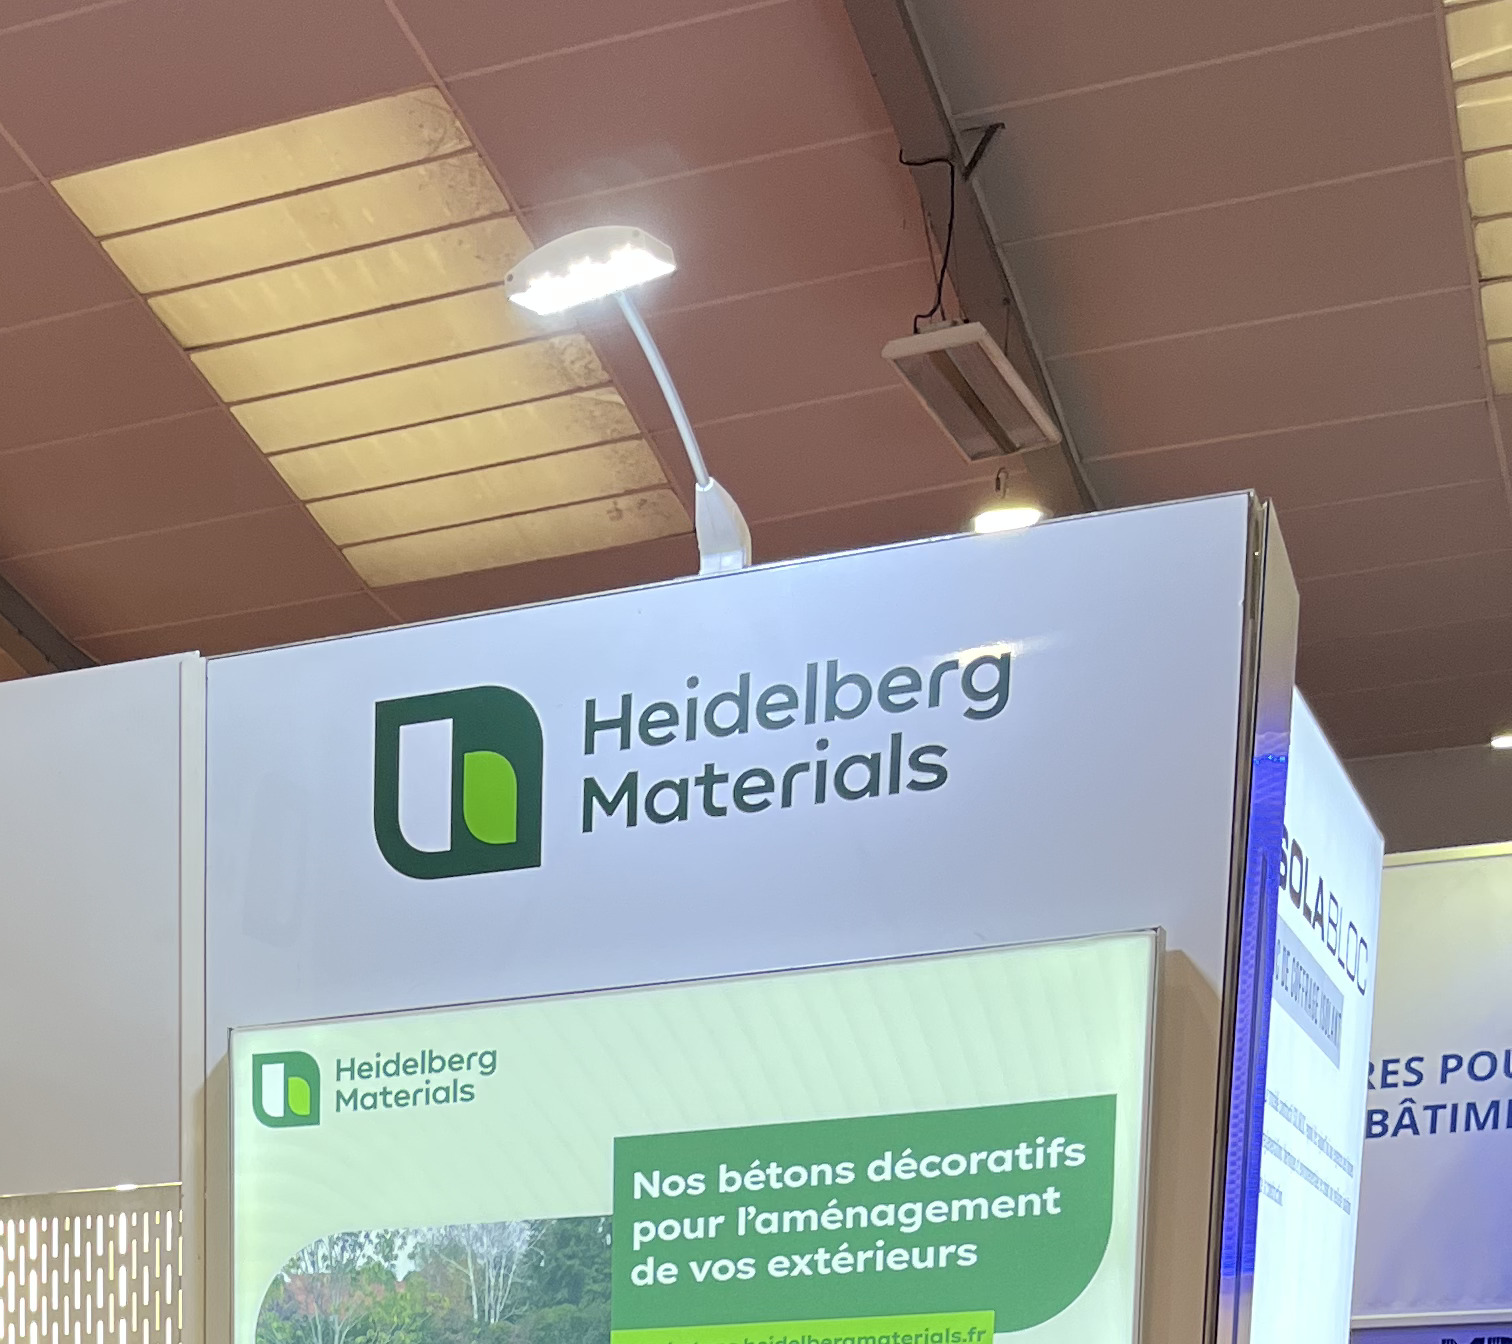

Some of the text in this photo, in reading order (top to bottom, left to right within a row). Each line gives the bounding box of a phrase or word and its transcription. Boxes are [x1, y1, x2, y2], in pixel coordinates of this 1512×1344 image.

[583, 651, 1012, 756] Heidelberg
[581, 731, 949, 834] Materials
[335, 1048, 497, 1081] Heidelberg
[335, 1078, 476, 1113] Materials
[1365, 1097, 1512, 1140] BÂTIM
[632, 1136, 1087, 1201] Nos bétons décoratifs
[632, 1186, 1062, 1251] pour l’aménagement
[630, 1240, 978, 1287] de vos extérieurs
